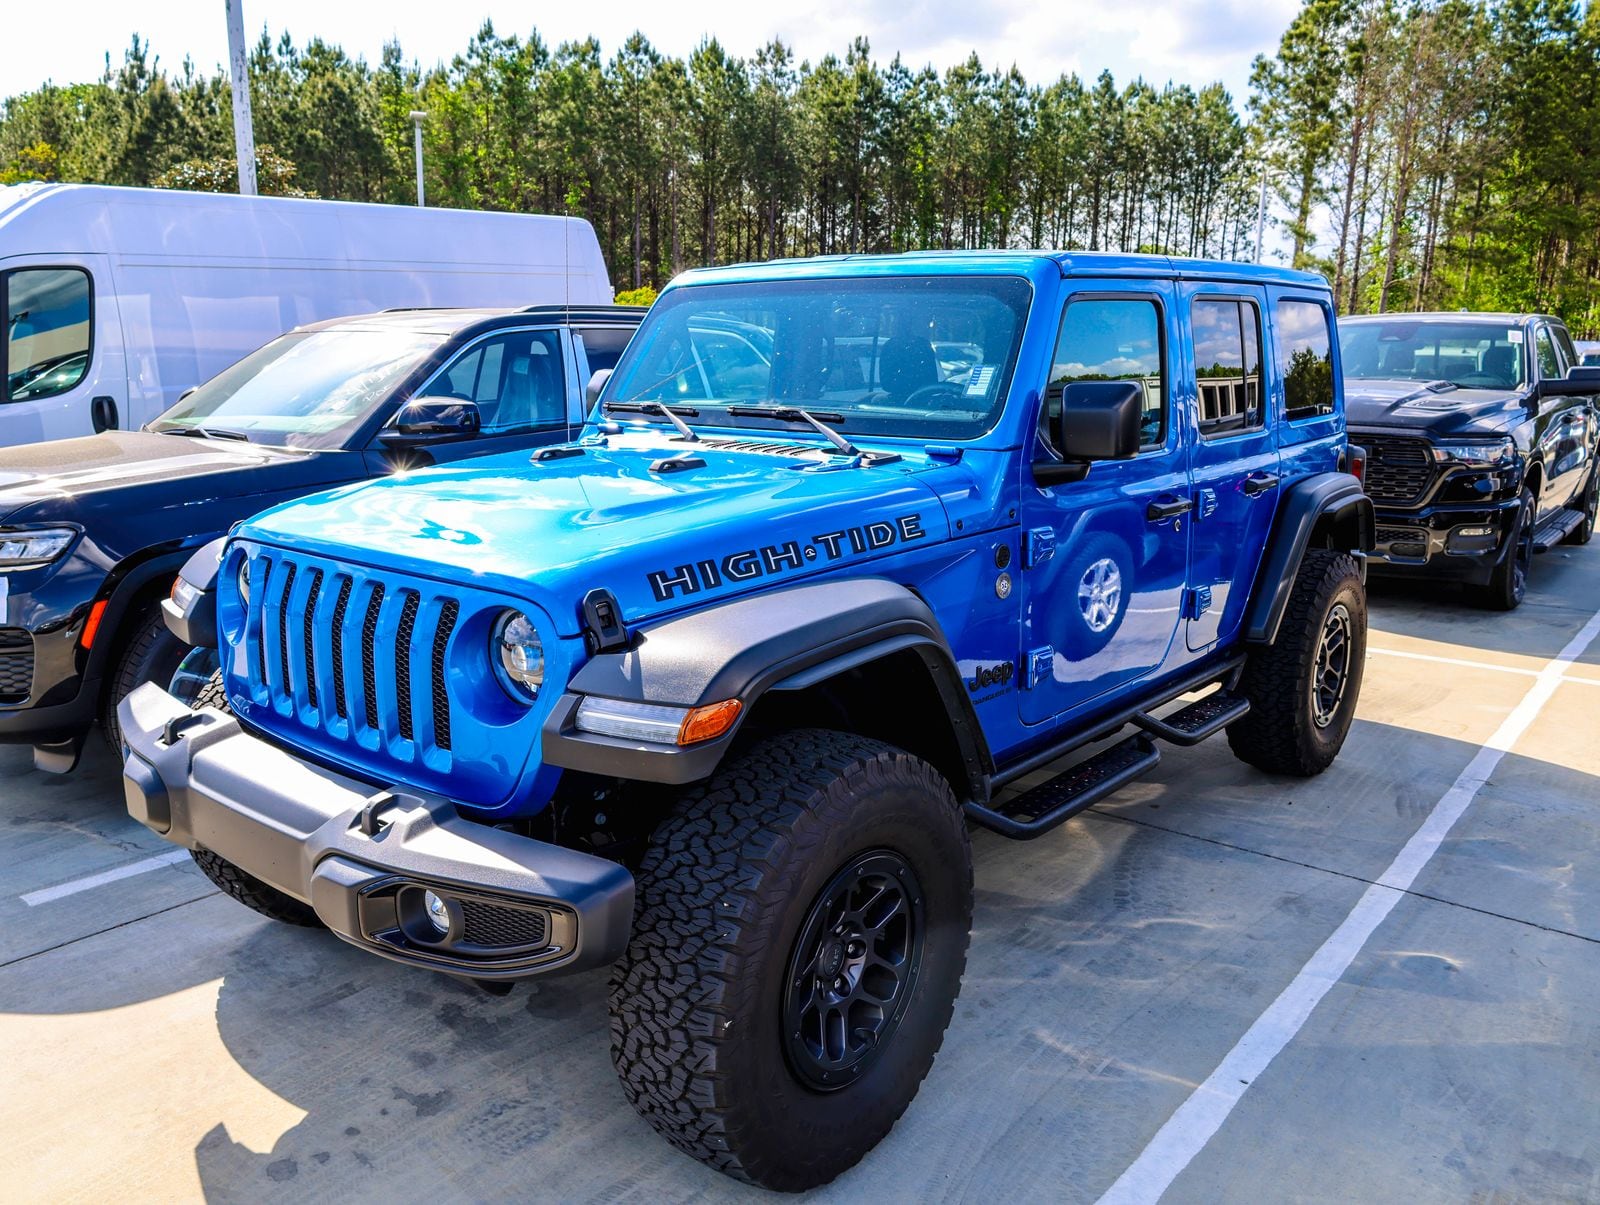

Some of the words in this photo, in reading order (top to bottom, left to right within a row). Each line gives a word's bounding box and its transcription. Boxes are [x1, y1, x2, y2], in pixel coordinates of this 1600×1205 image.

[646, 540, 804, 602] HIGH
[811, 513, 926, 561] TIDE
[969, 661, 1014, 693] Jeep
